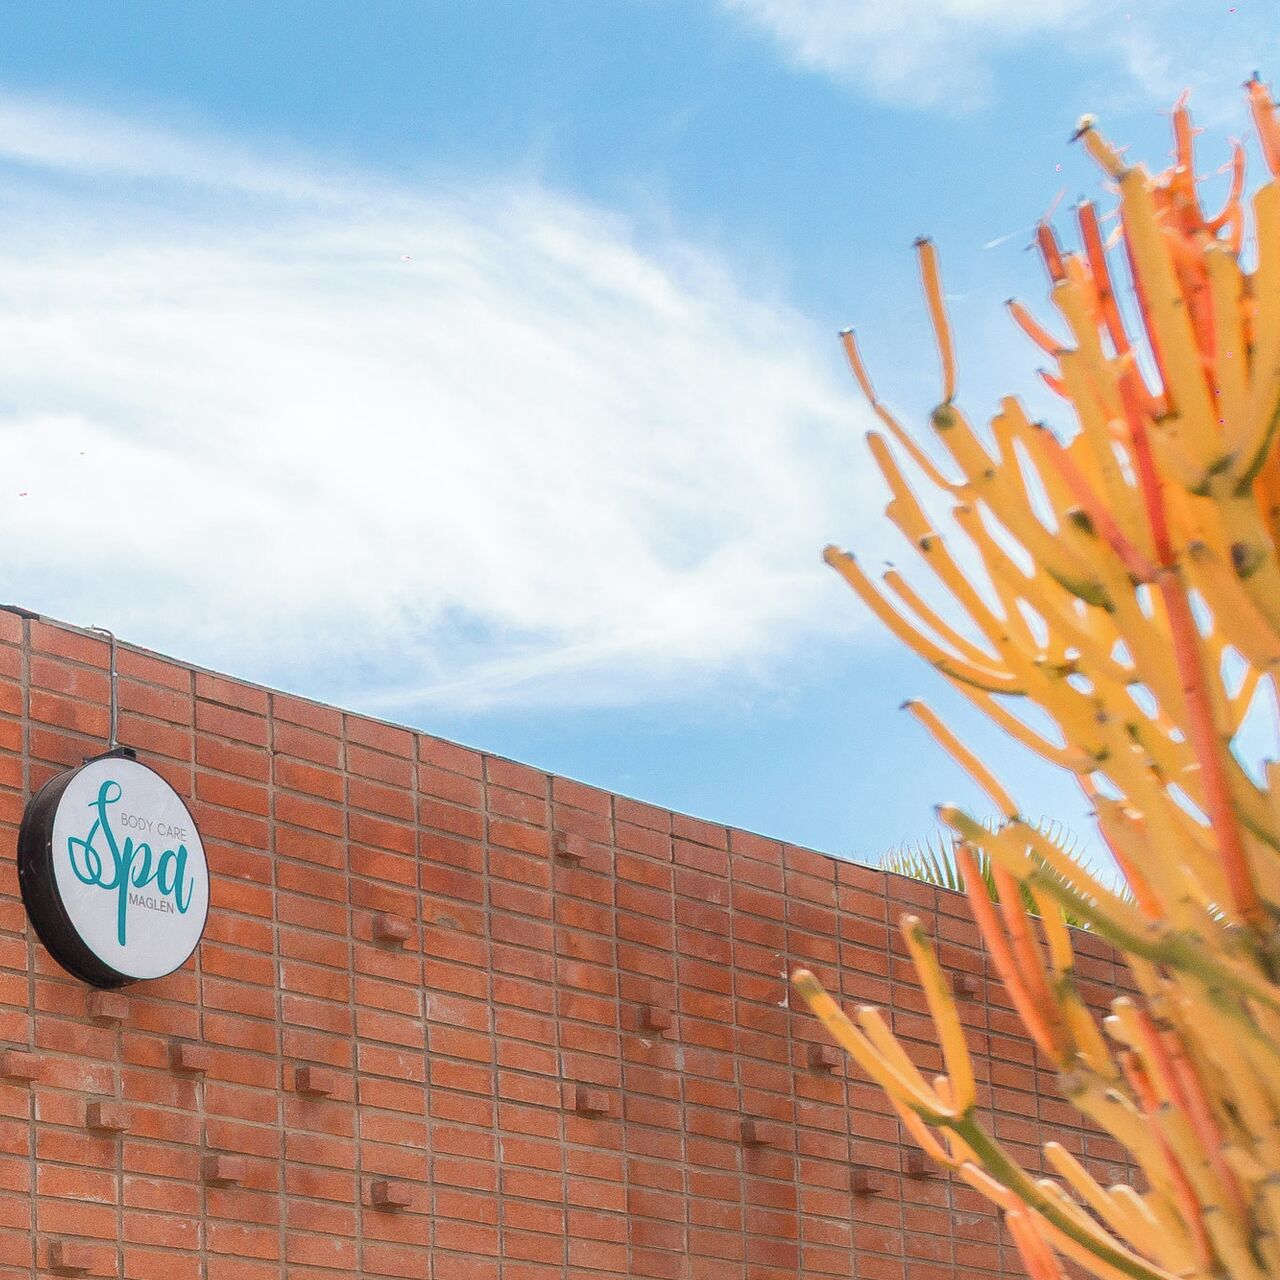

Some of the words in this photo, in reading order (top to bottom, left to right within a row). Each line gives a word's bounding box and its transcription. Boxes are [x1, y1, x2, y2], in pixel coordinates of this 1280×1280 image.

[121, 812, 154, 832] BODY
[157, 823, 187, 842] CARE
[68, 780, 194, 946] Spa
[128, 893, 175, 915] MAGLÉN
